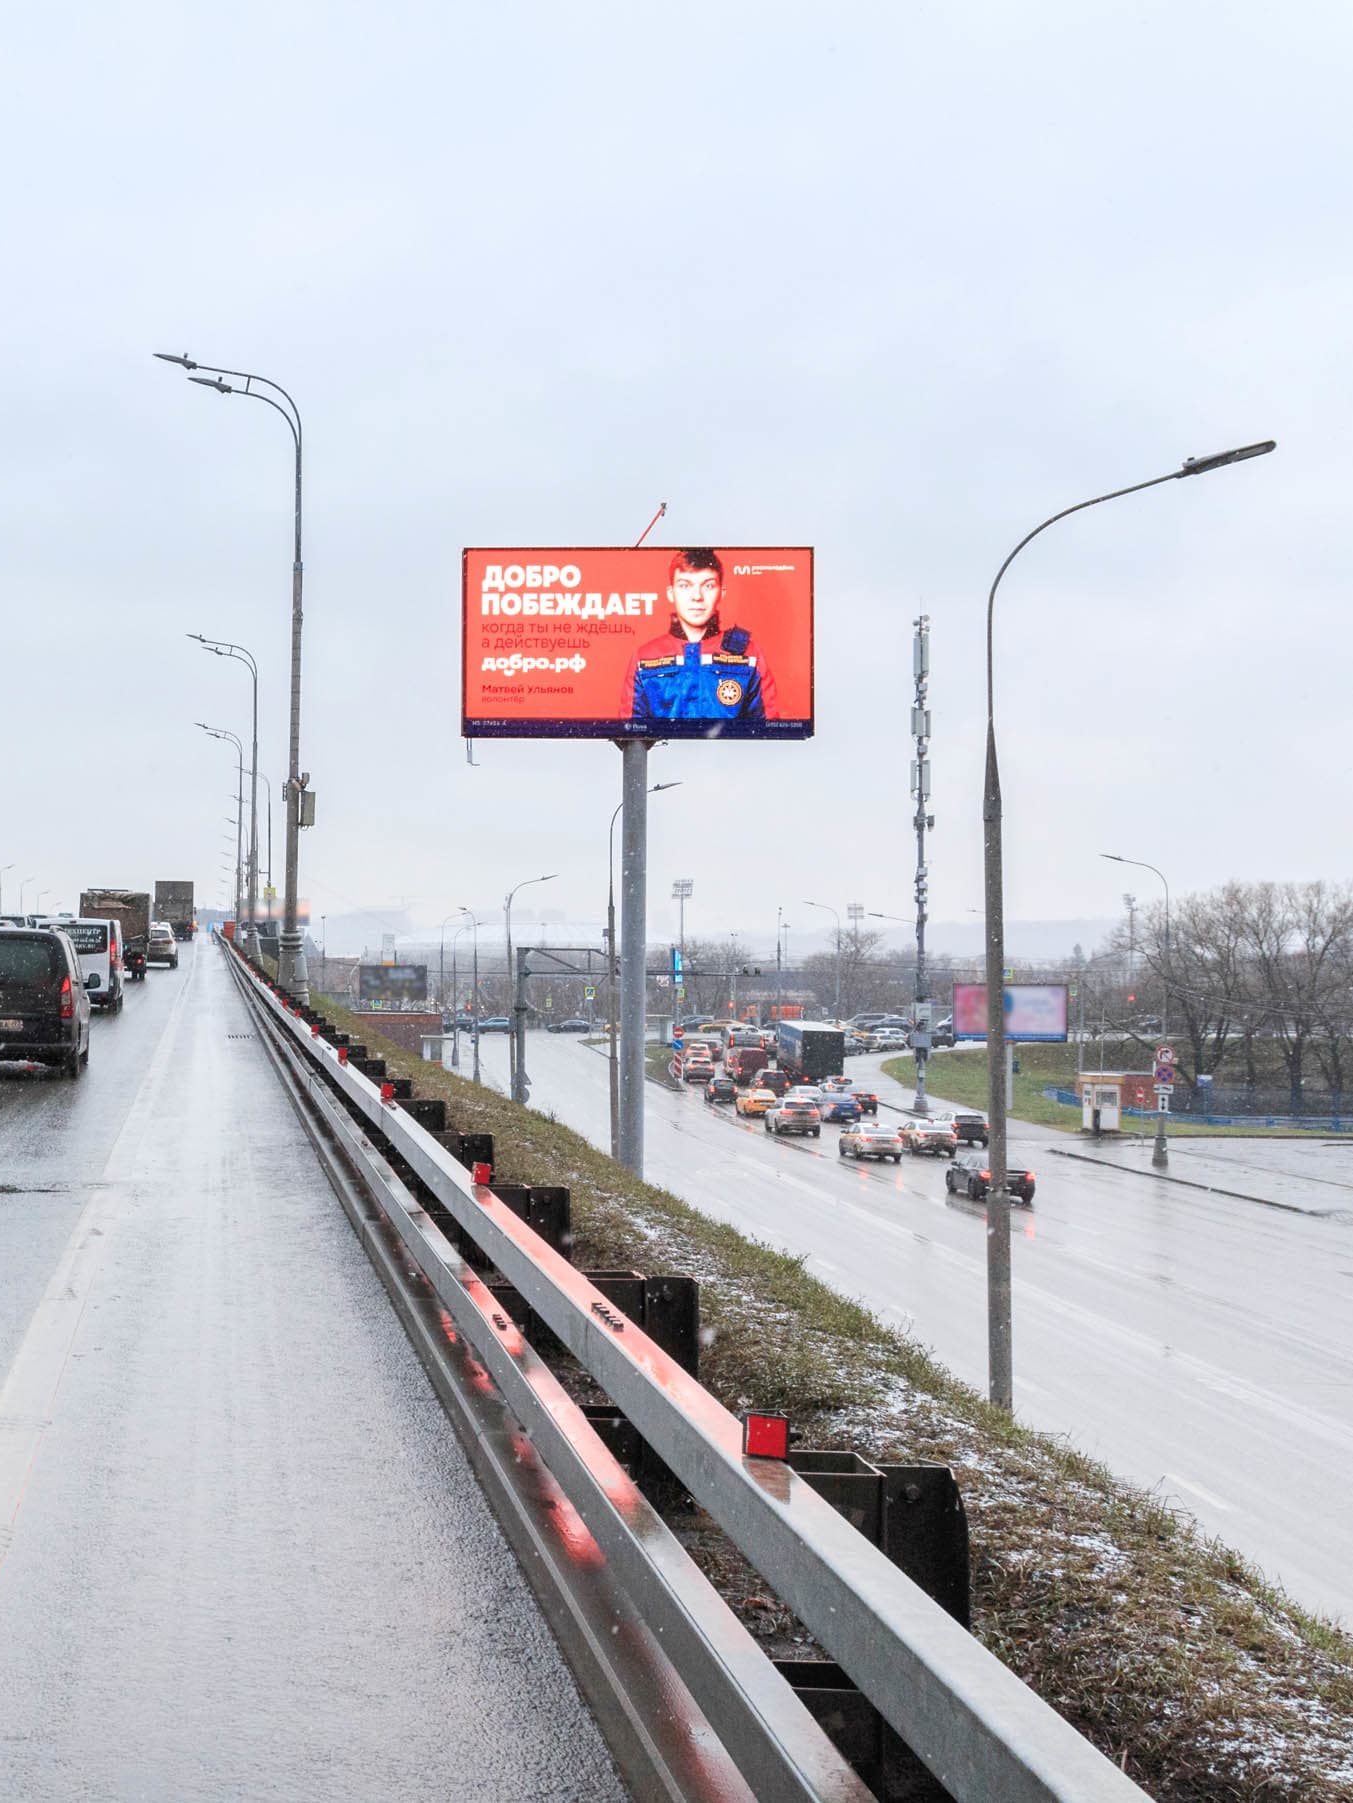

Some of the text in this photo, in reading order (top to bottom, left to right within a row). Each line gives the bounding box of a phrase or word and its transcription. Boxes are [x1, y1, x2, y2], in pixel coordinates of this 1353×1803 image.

[482, 565, 582, 592] ДОБРО
[481, 593, 659, 620] ПОБЕЖДАЕТ
[482, 622, 525, 635] когда
[530, 622, 551, 634] ты
[553, 622, 572, 634] не
[481, 634, 591, 652] а действуешь
[481, 653, 587, 674] добро.рф
[482, 683, 525, 694] Матвей
